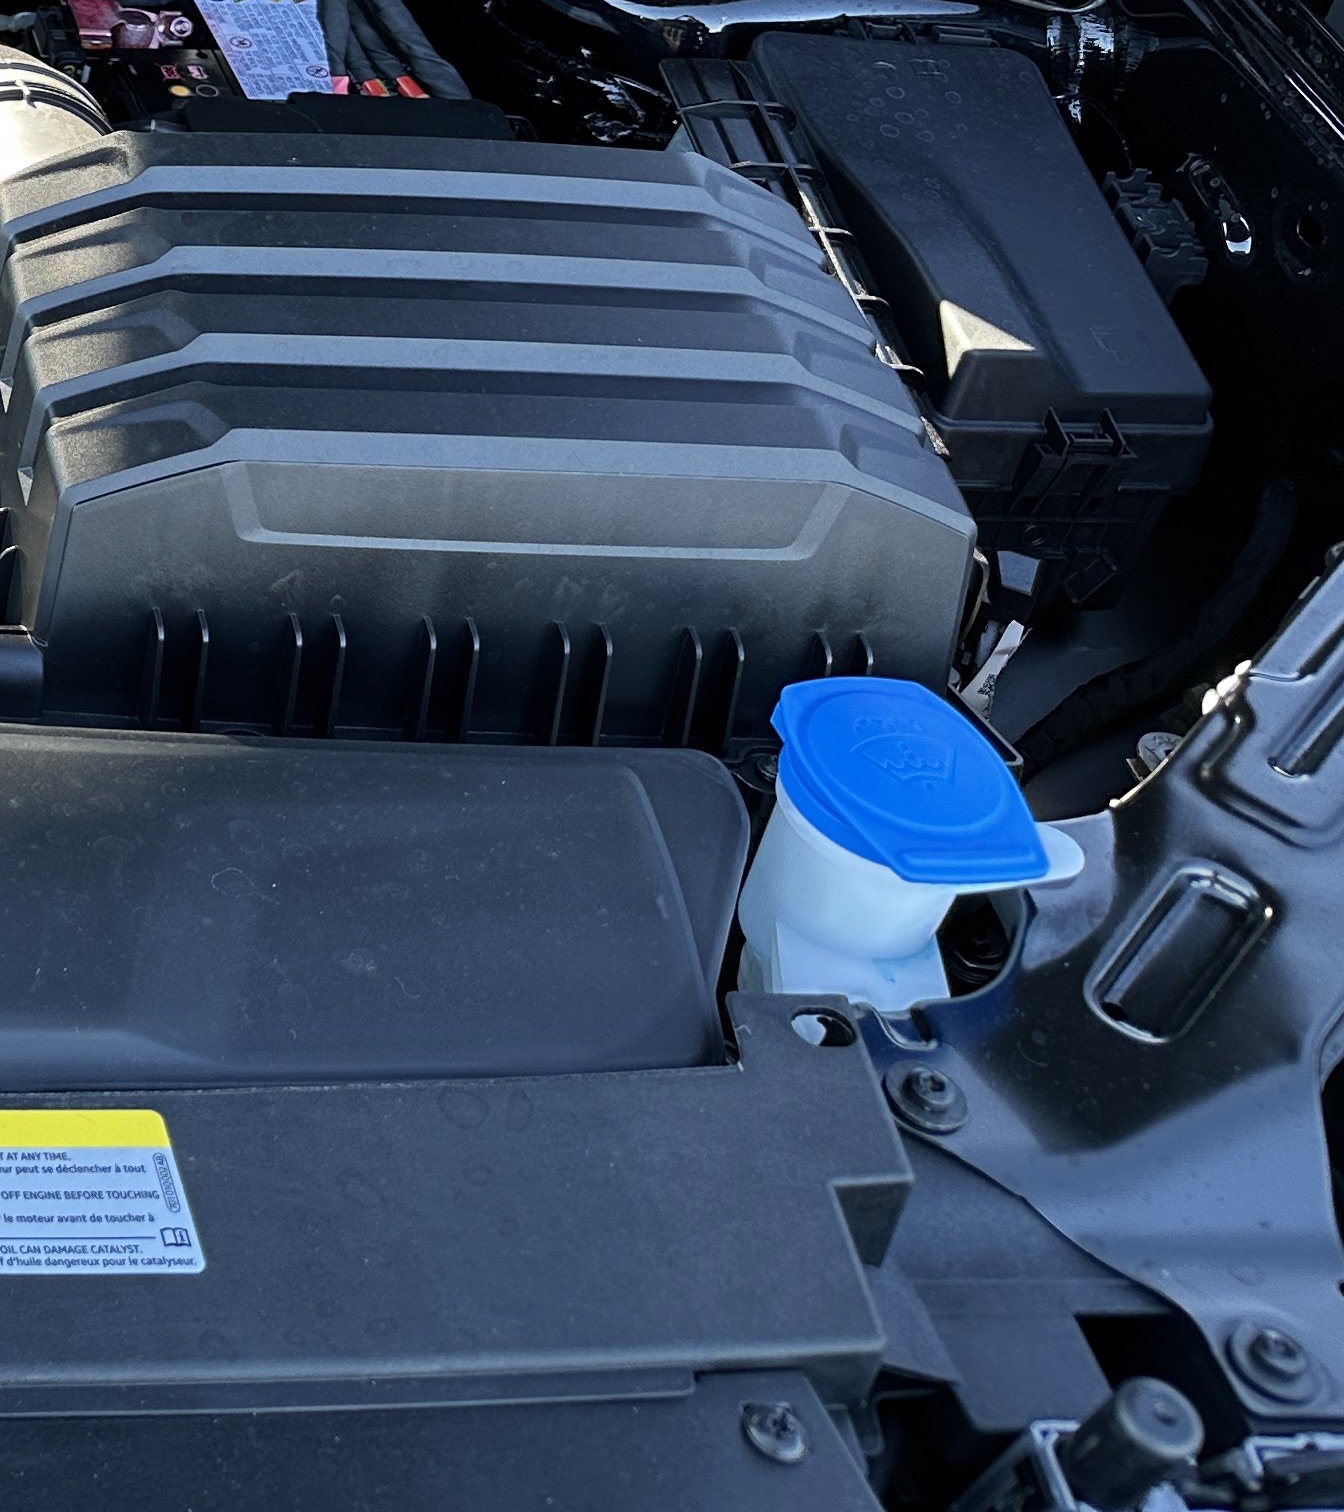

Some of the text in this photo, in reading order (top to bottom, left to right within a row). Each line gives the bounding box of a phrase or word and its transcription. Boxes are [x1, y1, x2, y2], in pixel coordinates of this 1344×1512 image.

[6, 1152, 18, 1161] AT
[21, 1152, 41, 1161] ANY
[44, 1152, 72, 1161] TIME.
[15, 1165, 39, 1175] peut
[56, 1165, 112, 1174] déclencher
[123, 1165, 146, 1173] tout
[0, 1191, 20, 1200] OFF
[23, 1191, 61, 1200] ENGINE
[64, 1191, 104, 1200] BEFORE
[107, 1191, 160, 1200] TOUCHING
[4, 1213, 13, 1222] le
[16, 1215, 54, 1223] moteur
[57, 1214, 87, 1223] avant
[89, 1214, 103, 1222] de
[105, 1214, 145, 1222] toucher
[0, 1245, 17, 1254] OIL
[19, 1245, 41, 1254] CAN
[43, 1245, 87, 1254] DAMAGE
[91, 1245, 143, 1254] CATALYST.
[44, 1257, 99, 1268] dangereux
[102, 1258, 126, 1267] pour
[128, 1257, 138, 1265] le
[141, 1257, 197, 1267] catalyseur.
